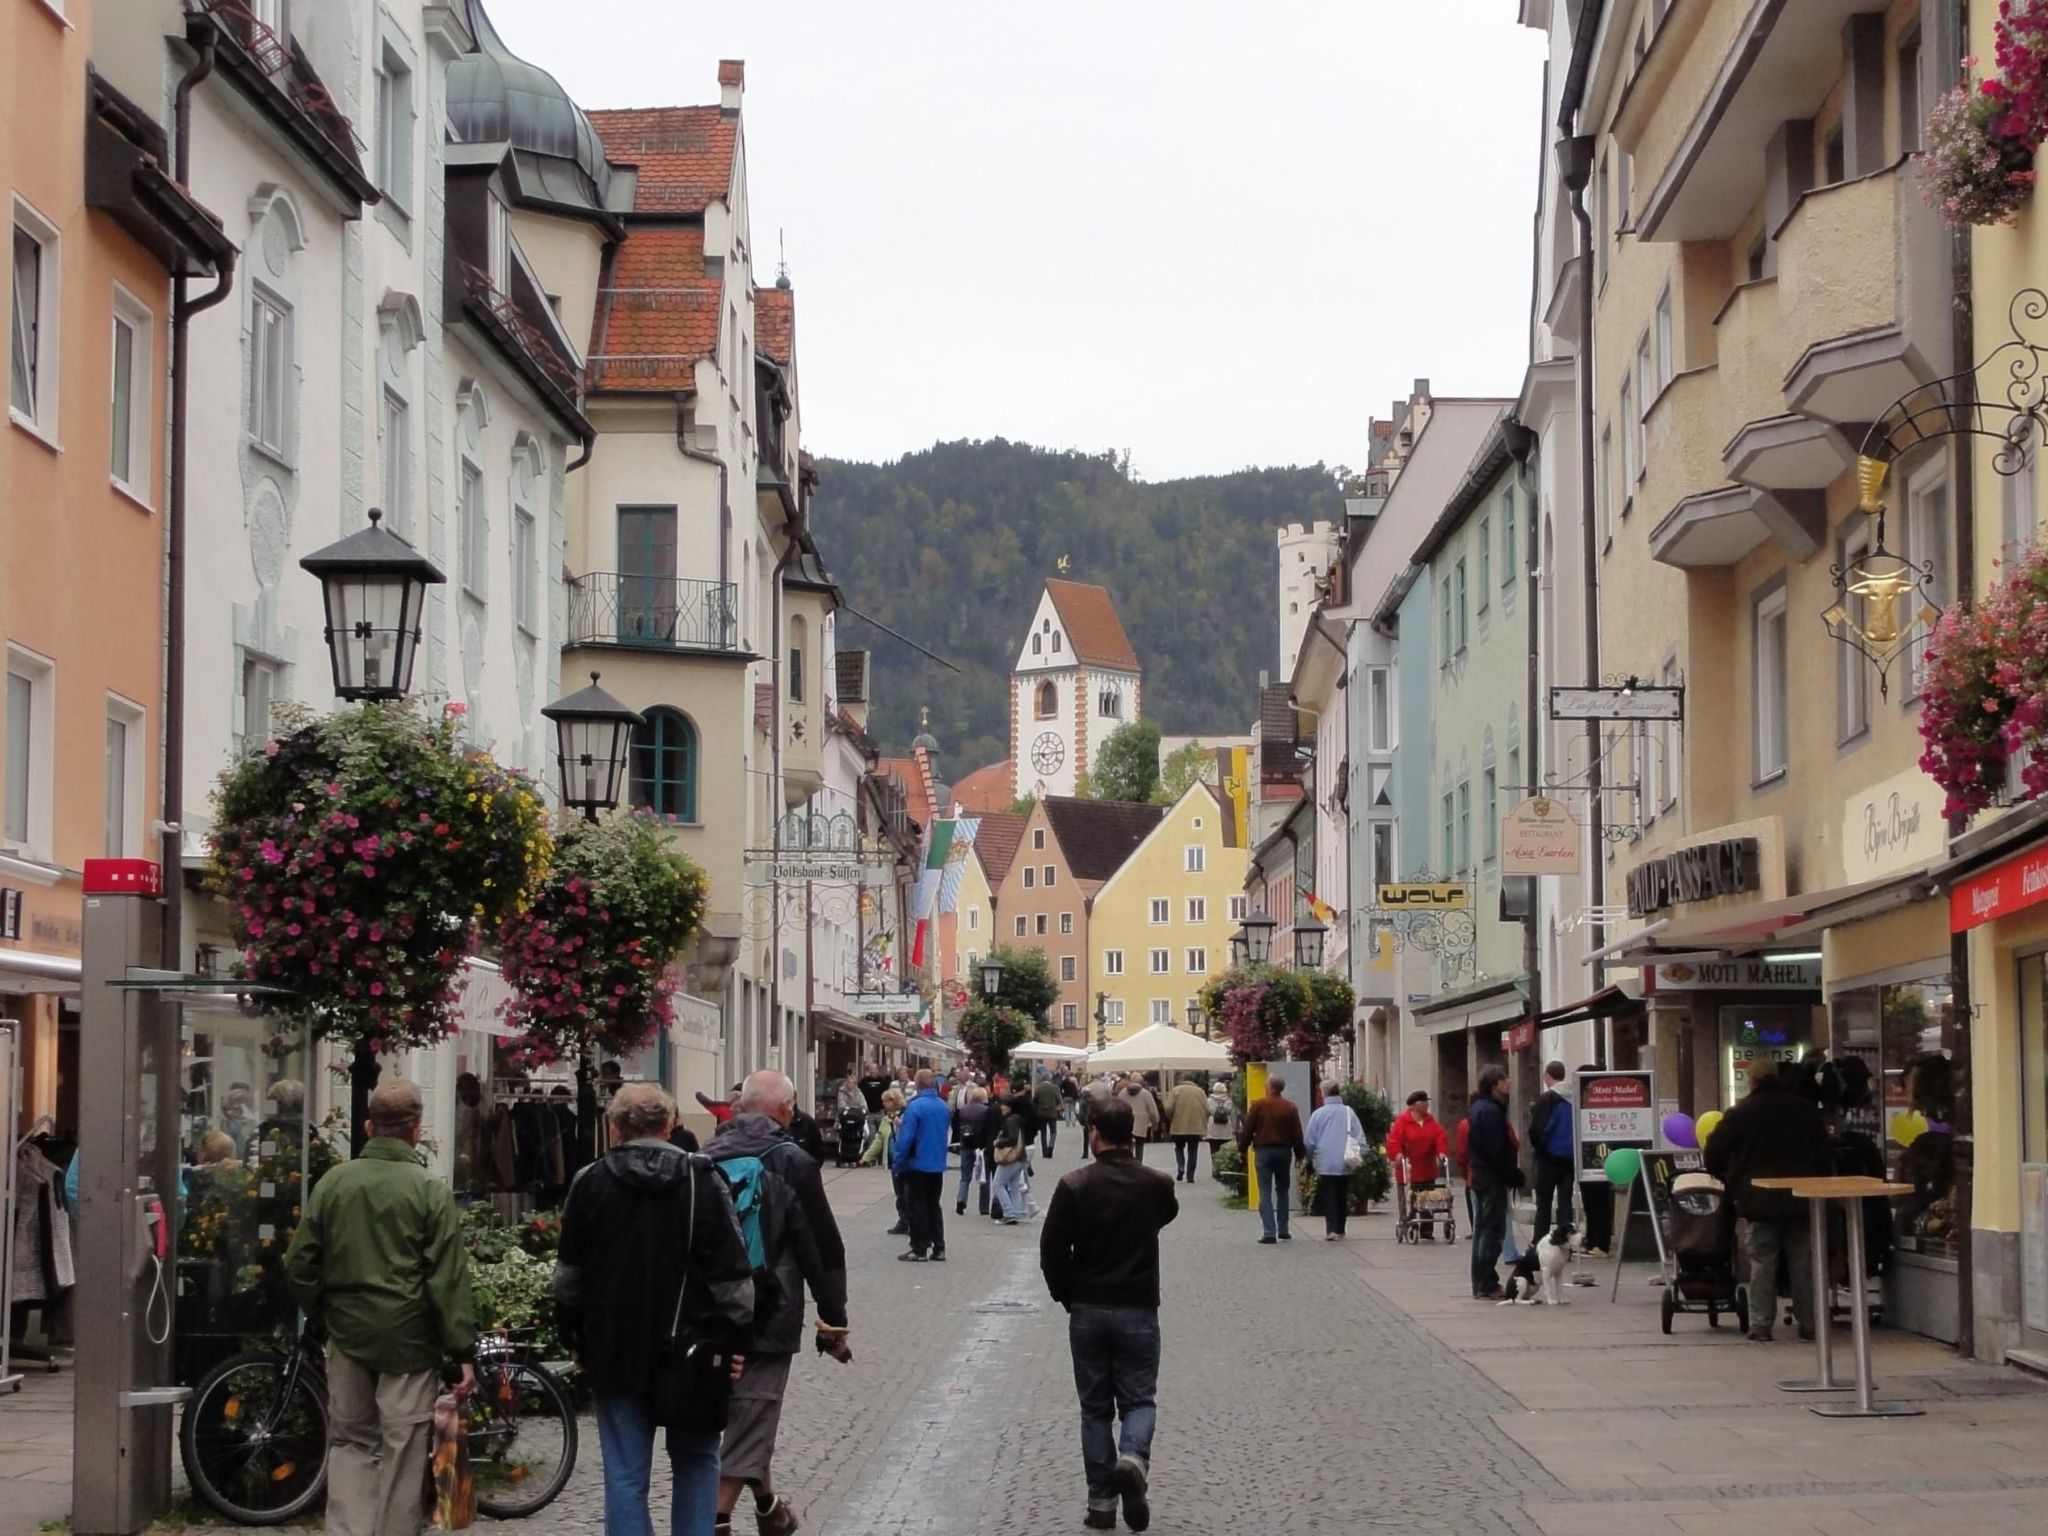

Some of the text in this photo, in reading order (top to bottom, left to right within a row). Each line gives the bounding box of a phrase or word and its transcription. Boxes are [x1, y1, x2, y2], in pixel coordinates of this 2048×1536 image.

[1382, 889, 1465, 904] WOLF
[1698, 964, 1738, 983] MOTI
[1747, 964, 1807, 984] MAHEL
